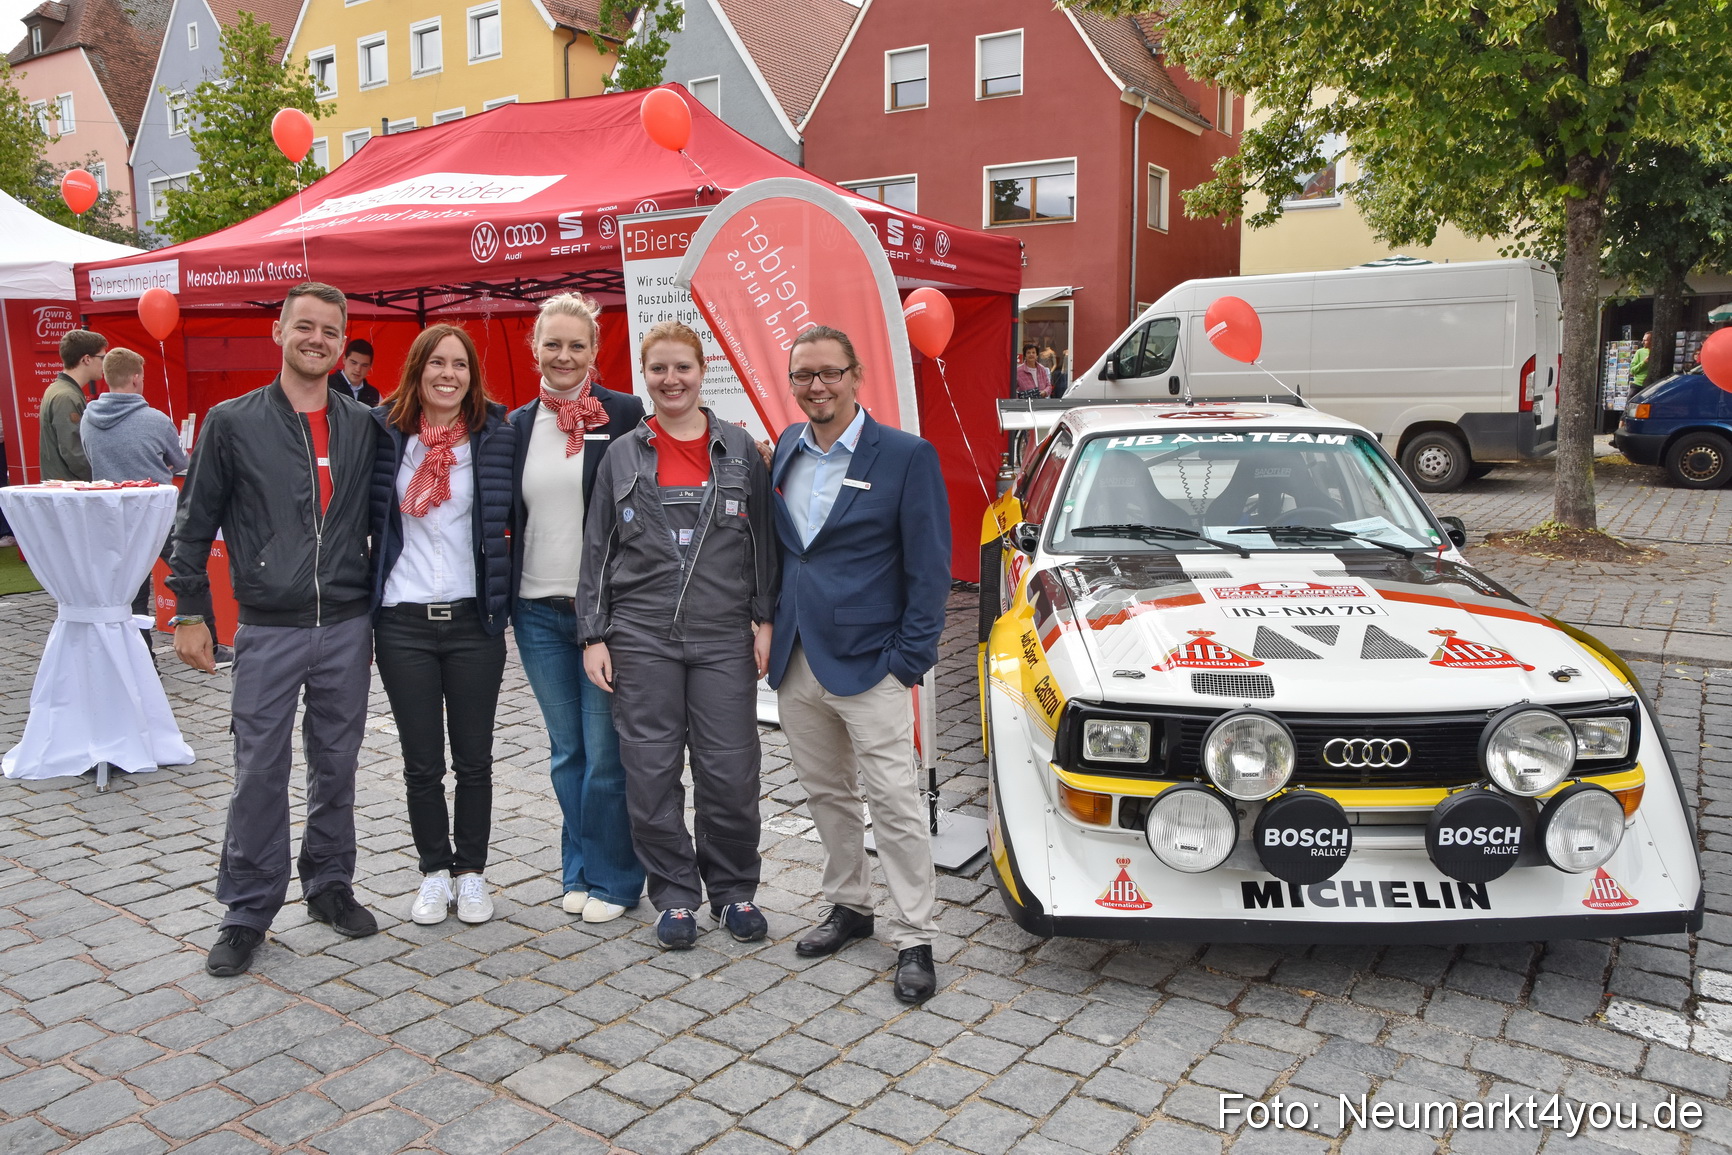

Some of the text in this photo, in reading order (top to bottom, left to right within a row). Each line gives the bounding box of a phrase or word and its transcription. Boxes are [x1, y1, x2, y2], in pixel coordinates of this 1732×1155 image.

[357, 209, 412, 223] und
[402, 208, 477, 221] Autos.
[504, 251, 522, 261] Audi
[550, 243, 591, 256] SEAT
[186, 260, 307, 288] Menschen und Autos.
[637, 275, 653, 287] Wir
[657, 273, 677, 287] suc
[637, 292, 693, 306] Auszubilde
[33, 305, 73, 321] Town &
[638, 310, 653, 324] für
[657, 310, 673, 322] die
[36, 318, 77, 338] Country
[1106, 431, 1348, 450] HB Audi TEAM
[1220, 589, 1276, 597] RALLYE
[1338, 605, 1376, 617] 70
[1020, 629, 1039, 670] Audi Sport
[1177, 643, 1233, 660] HB
[1437, 643, 1504, 661] HB
[1034, 675, 1062, 719] Castrol
[1264, 828, 1348, 847] BOSCH
[1439, 826, 1521, 846] BOSCH
[1311, 848, 1347, 857] RALLYE
[1483, 846, 1519, 855] RALLYE
[1109, 880, 1138, 902] HB
[1240, 879, 1492, 910] MICHELIN
[1590, 877, 1622, 900] HB
[1102, 901, 1145, 909] international
[1589, 899, 1633, 908] international
